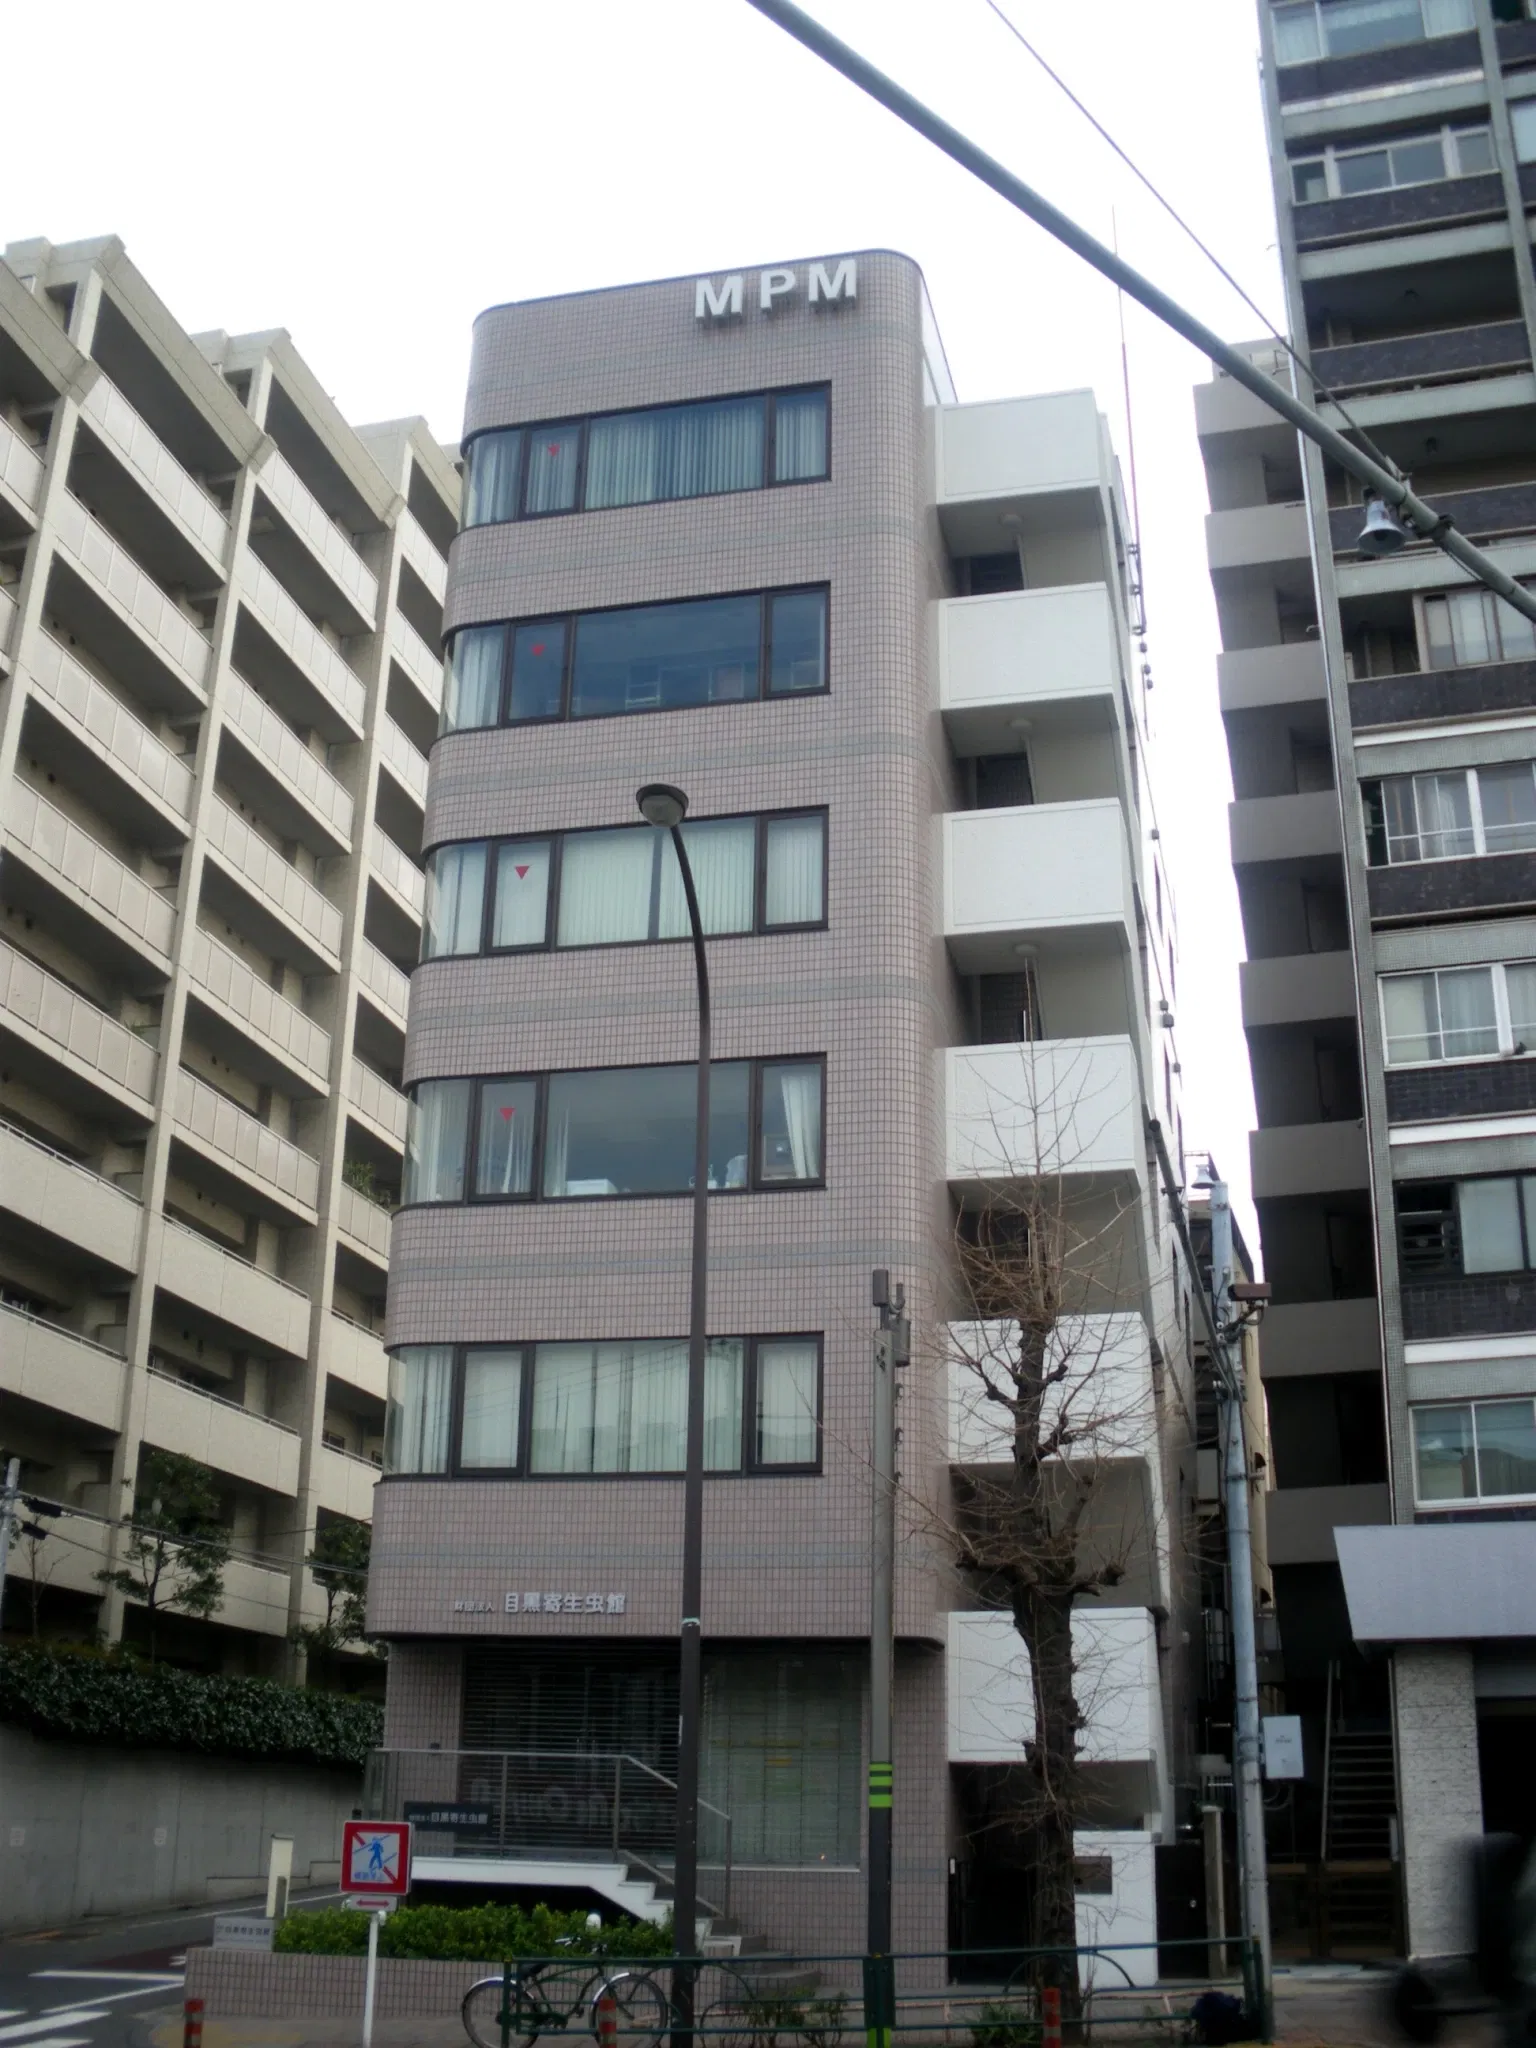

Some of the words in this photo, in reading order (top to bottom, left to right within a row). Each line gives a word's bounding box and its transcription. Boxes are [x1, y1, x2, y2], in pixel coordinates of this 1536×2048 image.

[695, 259, 858, 320] MPM
[505, 1592, 626, 1614] 目黒寄生虫館
